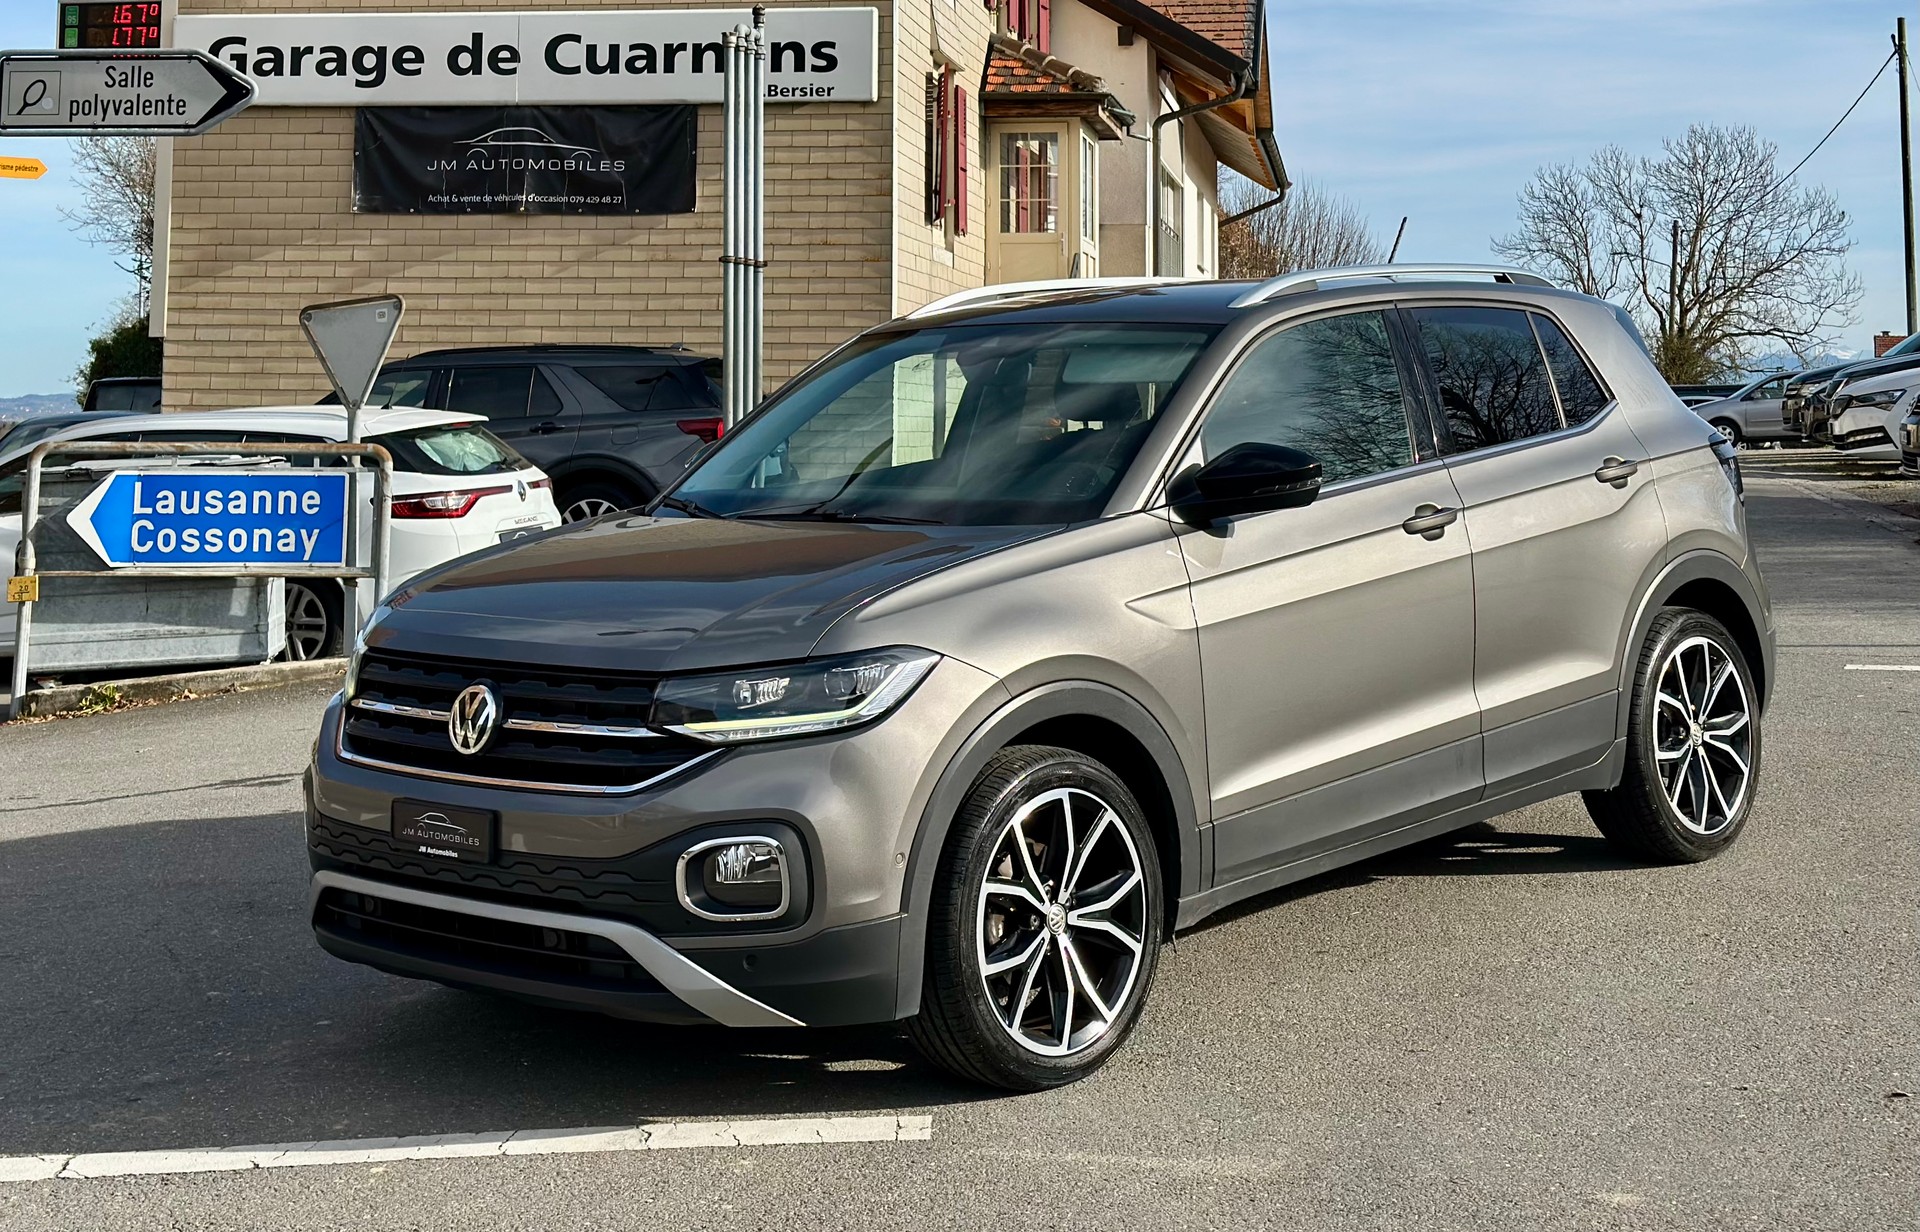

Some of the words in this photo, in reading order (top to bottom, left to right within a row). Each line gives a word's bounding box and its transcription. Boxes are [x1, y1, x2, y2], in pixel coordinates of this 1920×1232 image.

[67, 15, 76, 24] 95
[208, 36, 425, 88] Garage
[446, 32, 521, 76] de
[544, 33, 839, 75] Cuarnns
[104, 65, 154, 88] Salle
[69, 93, 187, 122] polyvalente
[427, 160, 457, 171] JM
[466, 158, 626, 171] AUTOMOBILES
[427, 194, 450, 202] Achat
[451, 194, 458, 202] &
[482, 194, 493, 202] de
[494, 193, 525, 202] véhicules
[527, 193, 568, 202] d'occasion
[569, 195, 585, 204] 079
[585, 195, 600, 204] 429
[601, 195, 611, 204] 48
[612, 196, 622, 204] 27
[133, 481, 321, 515] Lausanne
[131, 519, 320, 560] Cossonay
[417, 829, 480, 846] AUTOMOBILES
[418, 845, 427, 853] JM
[427, 846, 458, 857] Automobiles
